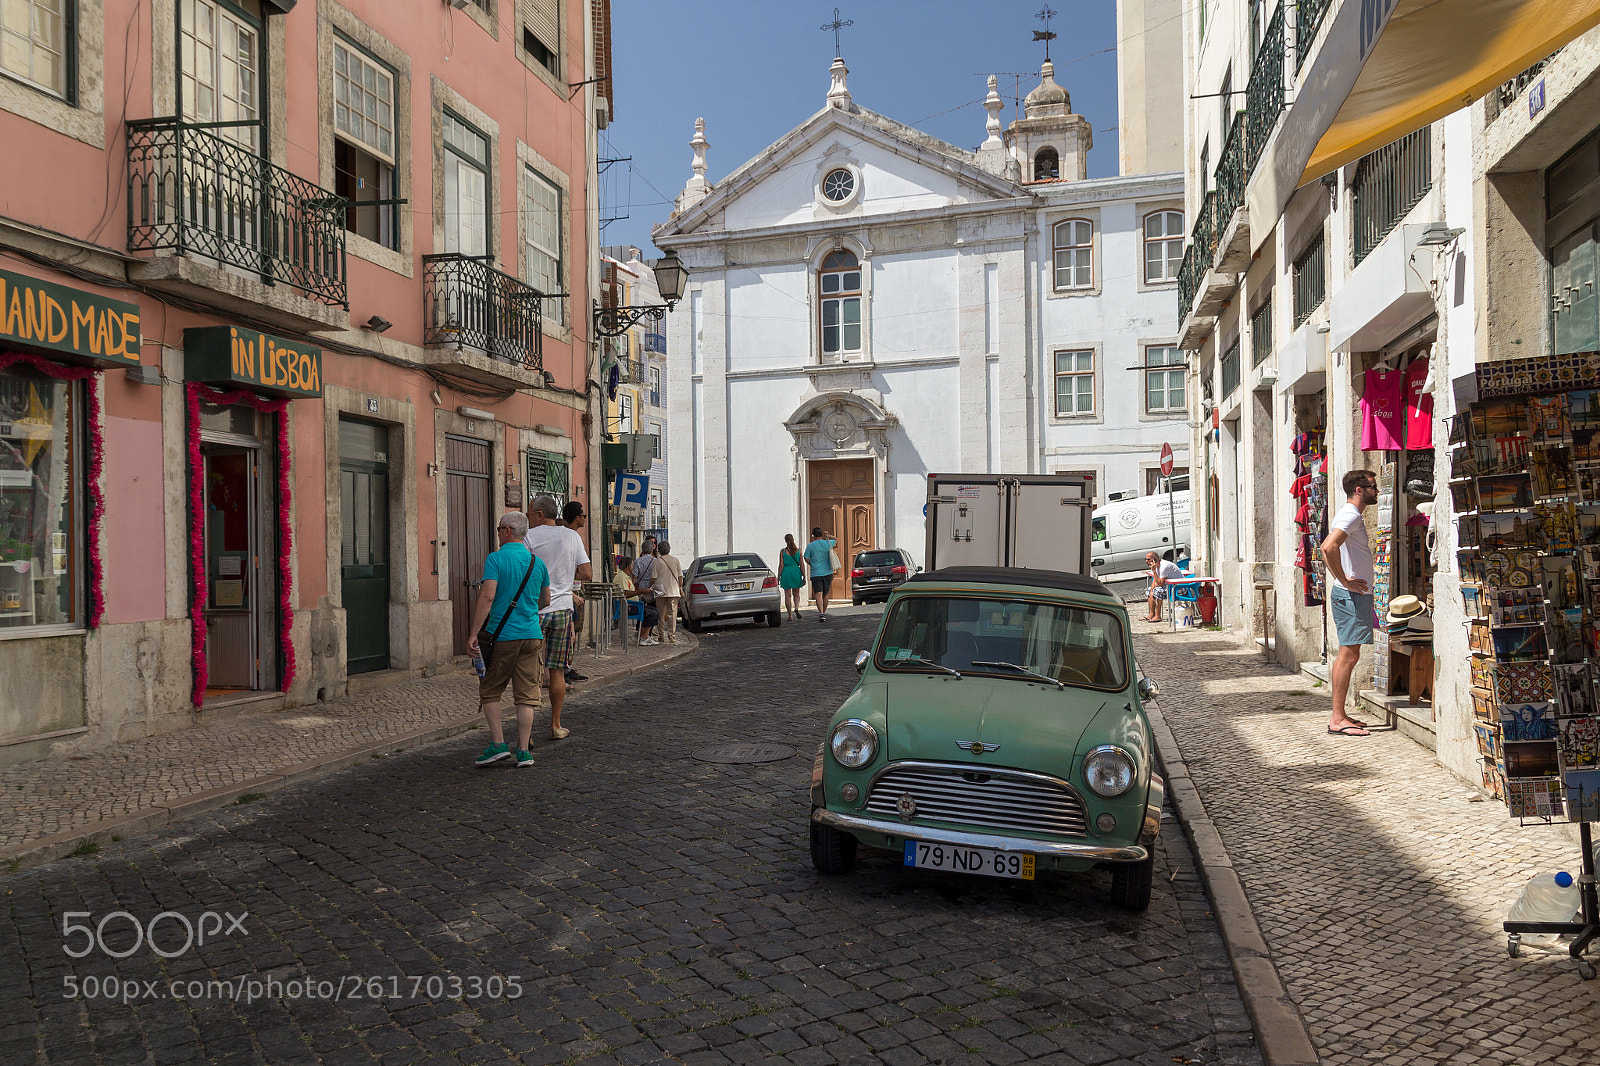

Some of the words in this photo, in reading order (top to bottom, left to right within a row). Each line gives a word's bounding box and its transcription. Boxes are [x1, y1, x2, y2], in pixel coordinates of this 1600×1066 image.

[71, 299, 140, 361] MADE
[1480, 373, 1533, 389] Portugal
[1414, 388, 1424, 418] 7
[621, 477, 641, 503] P
